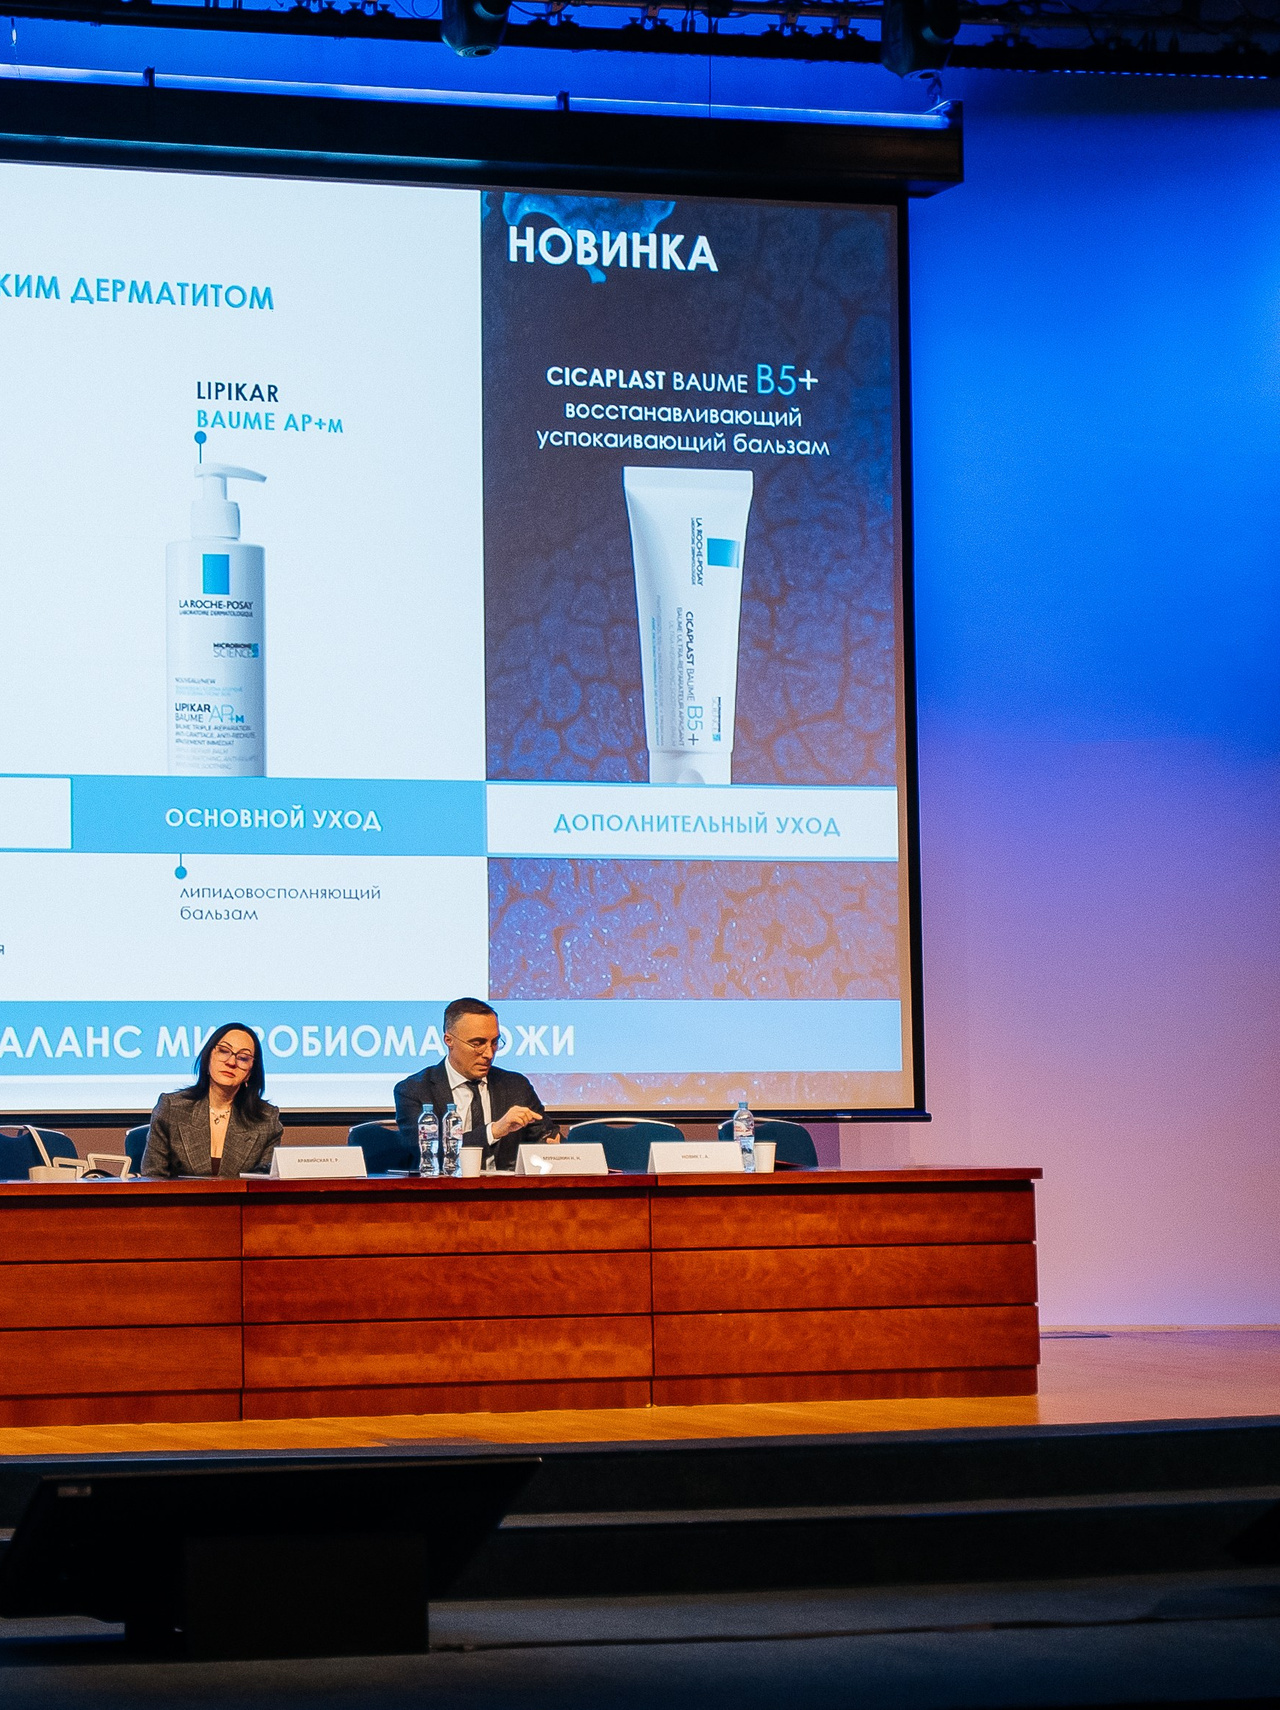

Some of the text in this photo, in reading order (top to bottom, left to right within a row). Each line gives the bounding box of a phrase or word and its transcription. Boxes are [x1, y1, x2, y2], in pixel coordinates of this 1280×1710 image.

[509, 225, 718, 272] НОВИНКА
[70, 277, 275, 311] ДЕРМАТИТОМ
[197, 381, 279, 403] LIPIKAR
[546, 364, 818, 396] CICAPLAST BAUME B5+
[197, 410, 276, 431] BAUME
[565, 402, 802, 428] восстанавливающий
[537, 429, 830, 456] успокаивающий бальзам
[696, 517, 703, 528] LA
[179, 600, 253, 610] LA ROCHE-POSAY
[686, 611, 694, 666] CICAPLAST
[686, 668, 695, 702] BAUME
[175, 702, 211, 712] LIPIKAR
[175, 713, 204, 723] BAUME
[165, 804, 382, 831] ОСНОВНОЙ УХОД
[553, 811, 840, 837] ДОПОЛНИТЕЛЬНЫЙ УХОД
[180, 885, 381, 900] липидовосполняющий
[180, 906, 258, 920] бальзам
